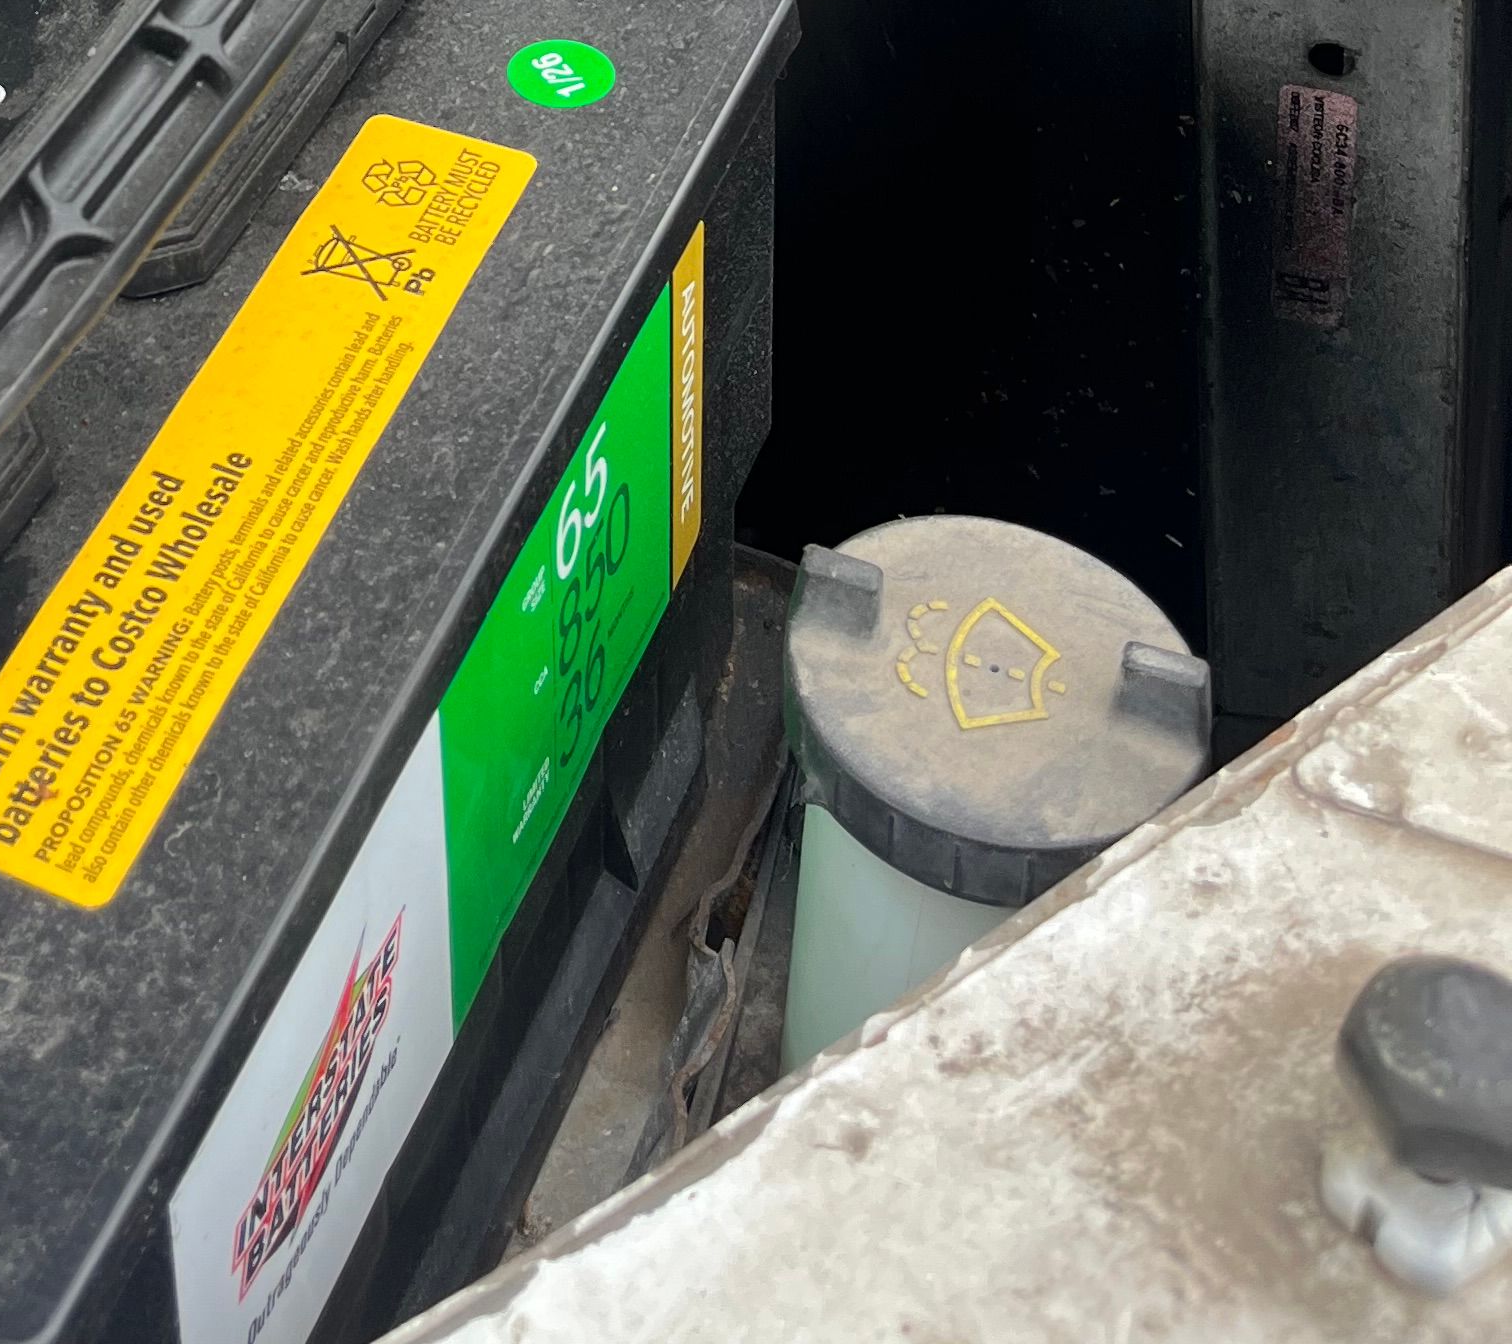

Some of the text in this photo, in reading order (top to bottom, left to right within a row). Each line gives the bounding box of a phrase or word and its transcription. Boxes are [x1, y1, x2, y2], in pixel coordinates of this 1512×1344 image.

[390, 173, 409, 189] Pb
[531, 52, 586, 98] 1/26
[402, 267, 435, 295] Pb
[407, 147, 482, 244] BATTERY MUST
[435, 159, 501, 244] BE RECYCLED
[556, 421, 608, 580] 65
[680, 280, 696, 525] AUTOMOTIVE
[7, 587, 114, 718] warranty
[90, 533, 143, 590] and
[126, 469, 185, 536] used
[33, 310, 381, 863] PROPOSITION 65 WARNING: Battery posts, terminals and related accessories contain lead and
[54, 314, 403, 873] lead compounds, chemicals known to the state of California to cause cancer and reproductive harm. Batteries
[69, 676, 111, 708] to
[90, 585, 168, 672] Costco
[143, 451, 253, 582] Wholesale
[80, 340, 415, 884] also contain other chemicals known to the state of California to cause cancer. Wash hands after handling.
[533, 665, 548, 695] CCA
[558, 482, 630, 677] 850
[560, 618, 605, 768] 36
[236, 928, 398, 1256] INTERSTATE
[245, 984, 388, 1284] BATTERIES
[248, 1045, 398, 1344] Outrageously Dependable
